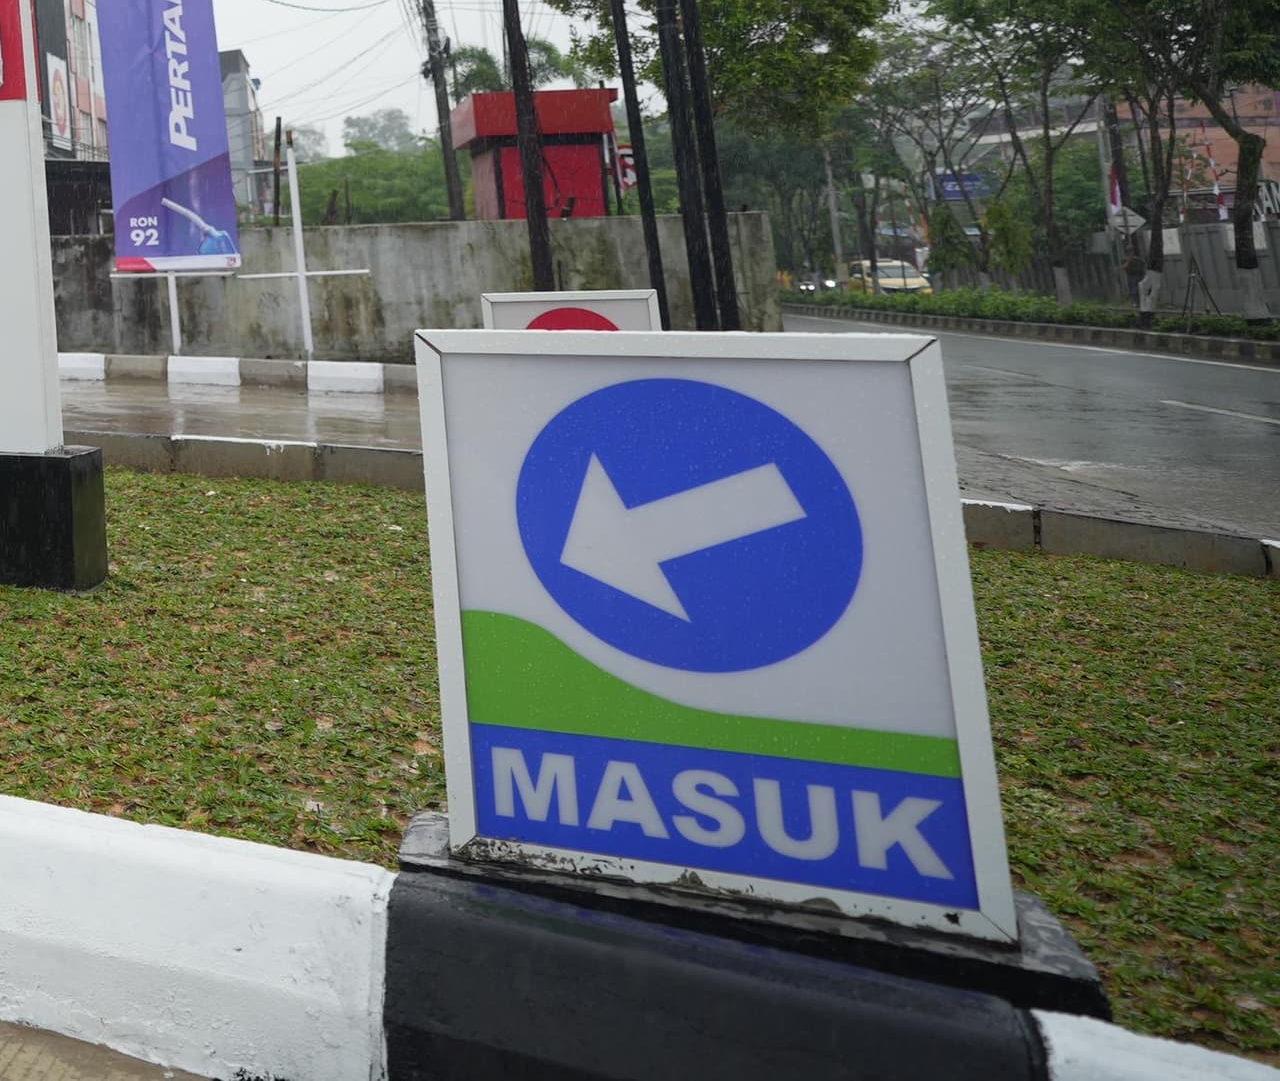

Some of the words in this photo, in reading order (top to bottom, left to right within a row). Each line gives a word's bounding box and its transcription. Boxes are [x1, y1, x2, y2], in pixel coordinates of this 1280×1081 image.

[130, 217, 158, 228] RON
[130, 229, 159, 246] 92
[491, 746, 955, 881] MASUK
